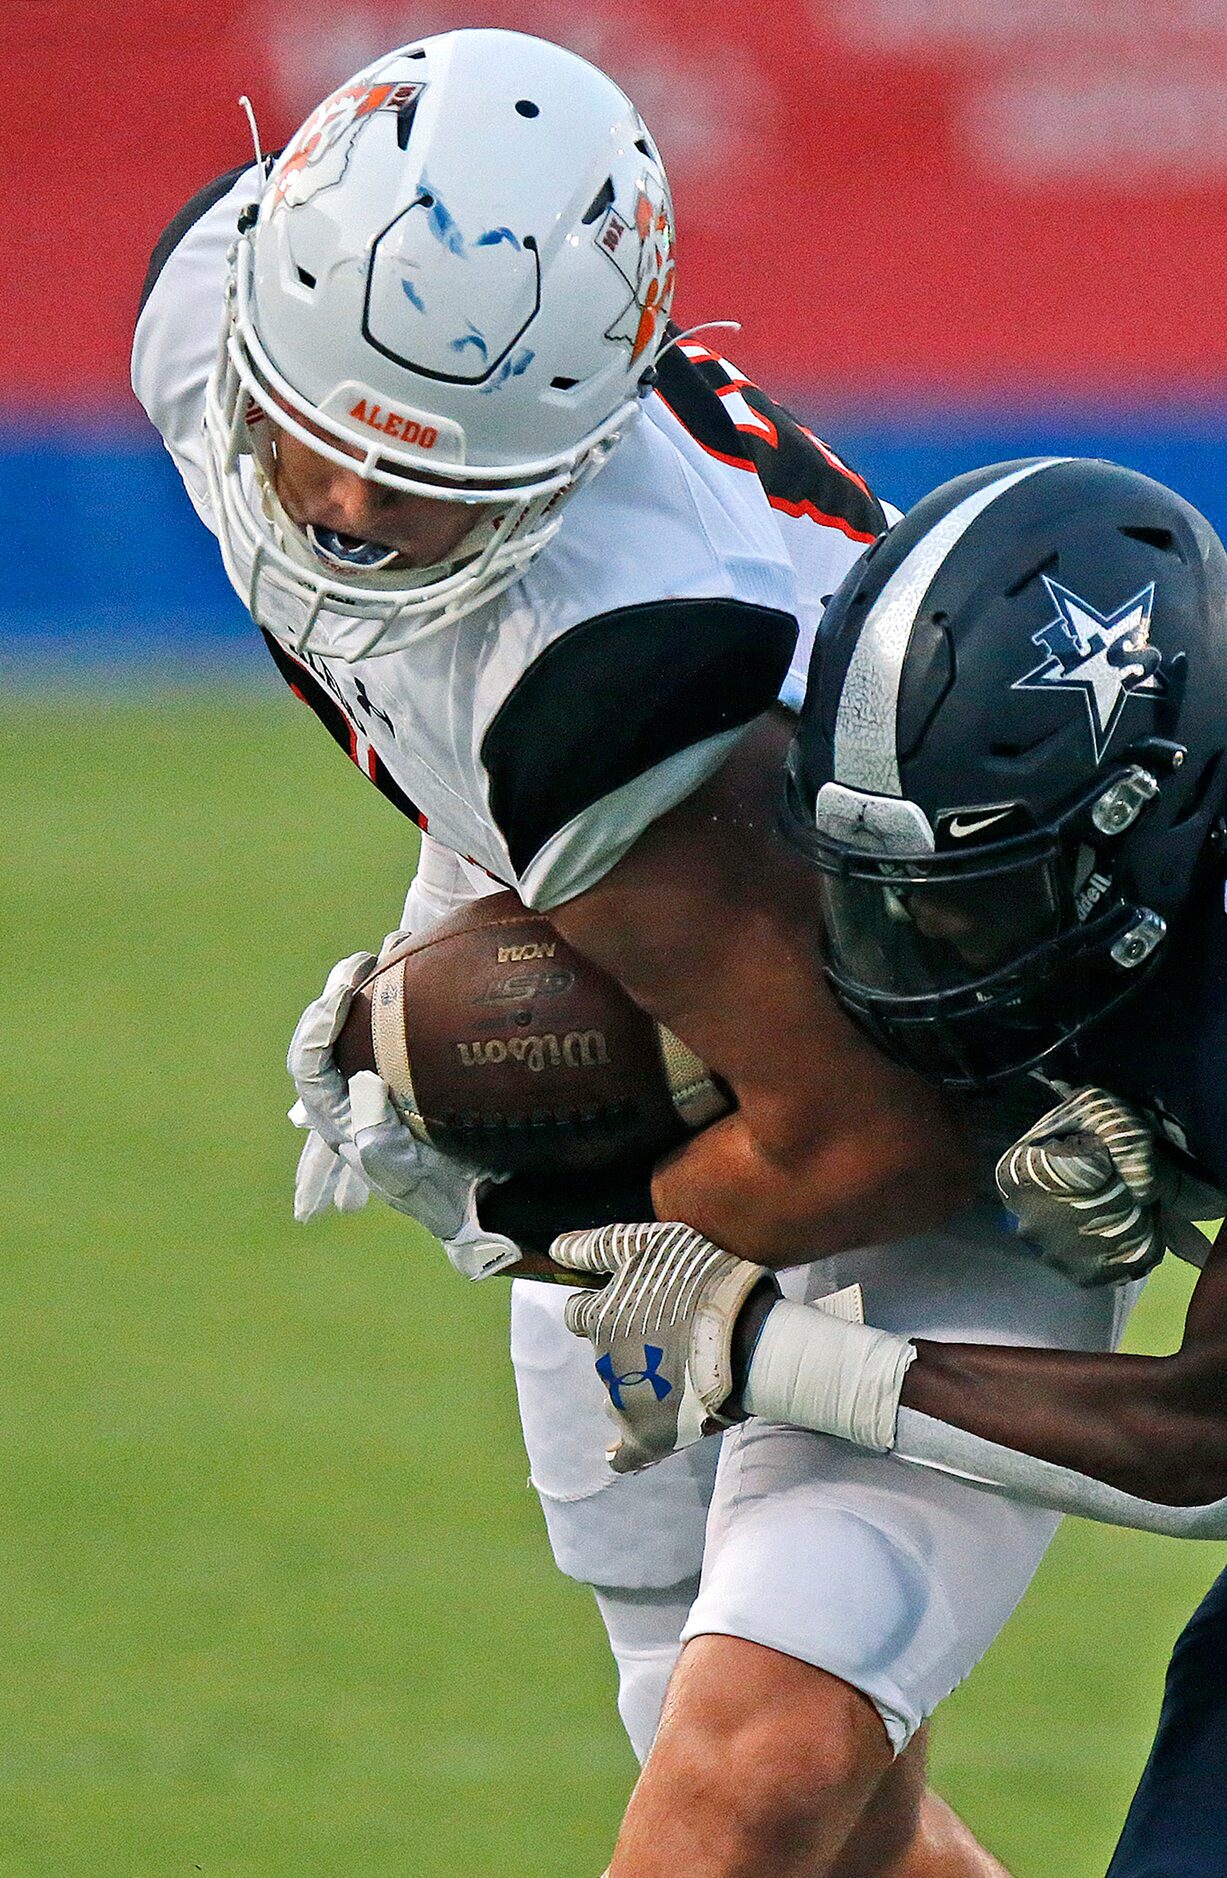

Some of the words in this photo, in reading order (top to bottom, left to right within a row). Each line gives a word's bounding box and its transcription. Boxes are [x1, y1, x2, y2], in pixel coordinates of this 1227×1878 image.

[348, 399, 438, 449] ALEDO
[497, 942, 557, 963] NCAA
[456, 1029, 612, 1072] Wilson
